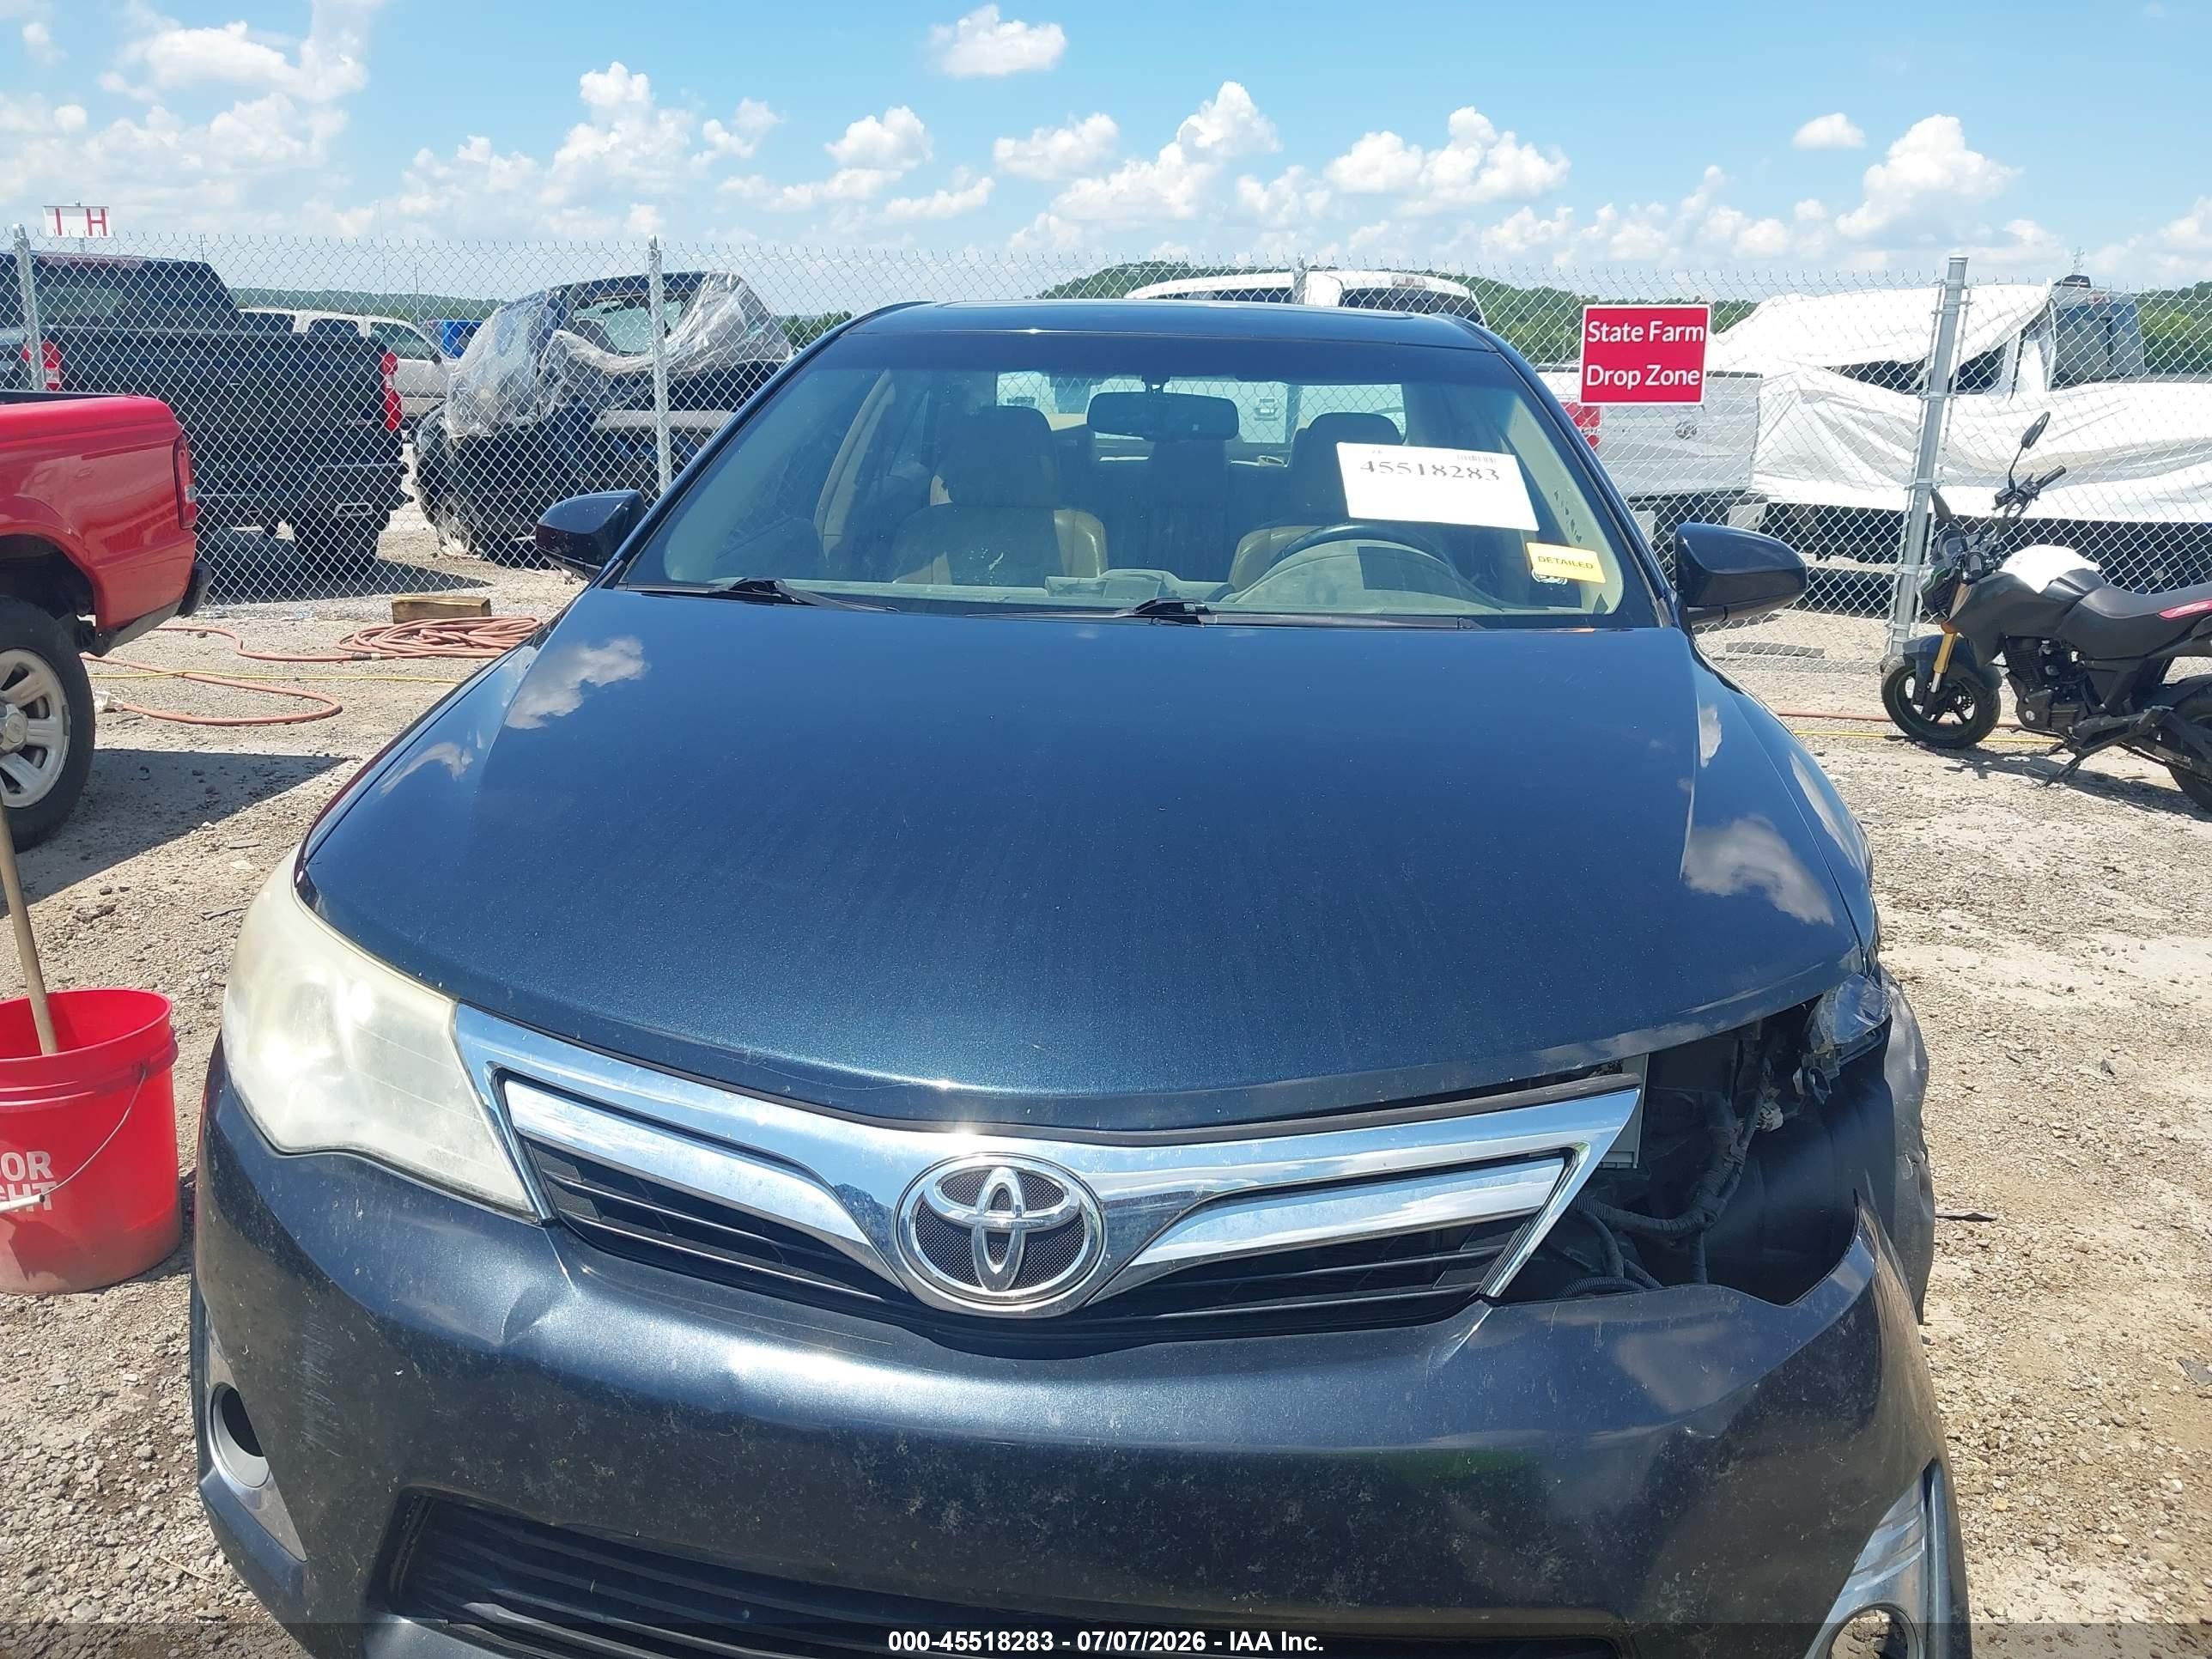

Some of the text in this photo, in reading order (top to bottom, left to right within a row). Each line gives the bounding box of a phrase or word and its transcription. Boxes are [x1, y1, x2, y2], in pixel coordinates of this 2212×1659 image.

[1587, 320, 1705, 343] State Farm
[1586, 365, 1700, 391] Drop Zone
[1359, 460, 1500, 482] 45518283
[1537, 556, 1595, 569] DETAILED
[0, 1151, 54, 1182] OR
